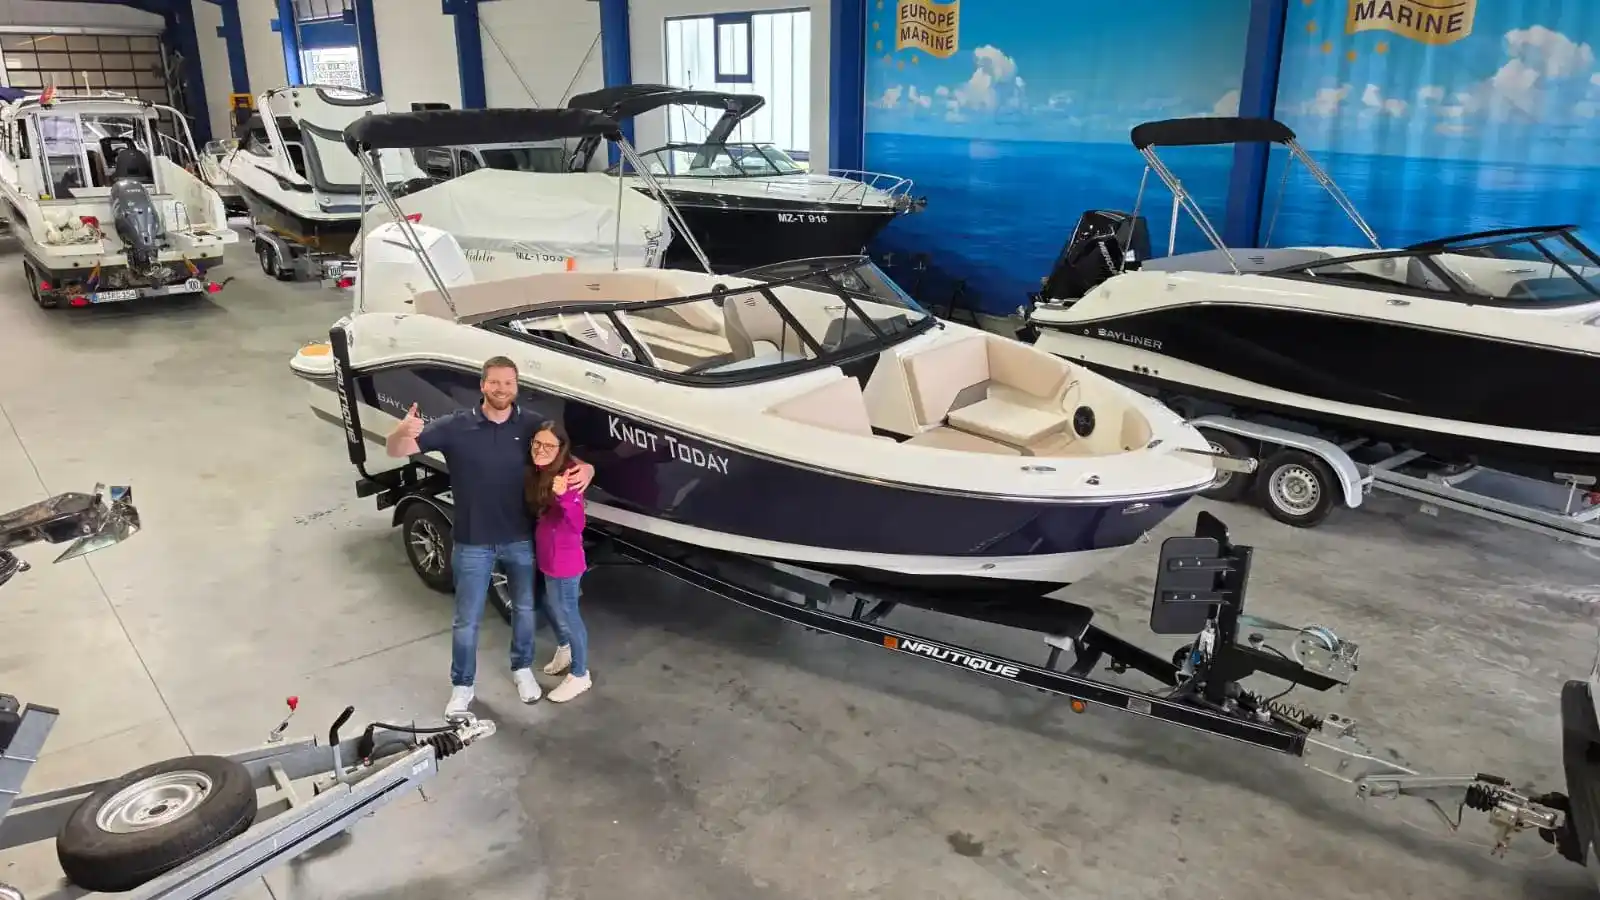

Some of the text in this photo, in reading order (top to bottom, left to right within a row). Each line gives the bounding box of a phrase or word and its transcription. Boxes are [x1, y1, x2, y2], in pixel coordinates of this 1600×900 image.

[901, 4, 955, 27] EUROPE
[1354, 0, 1464, 34] MARINE
[900, 26, 954, 50] MARINE
[777, 213, 805, 223] MZ-T
[1097, 328, 1163, 350] BAYLINER
[333, 356, 360, 444] NAUTIQUE
[608, 415, 729, 475] KNOT TODAY
[901, 639, 1020, 678] NAUTIQUE
